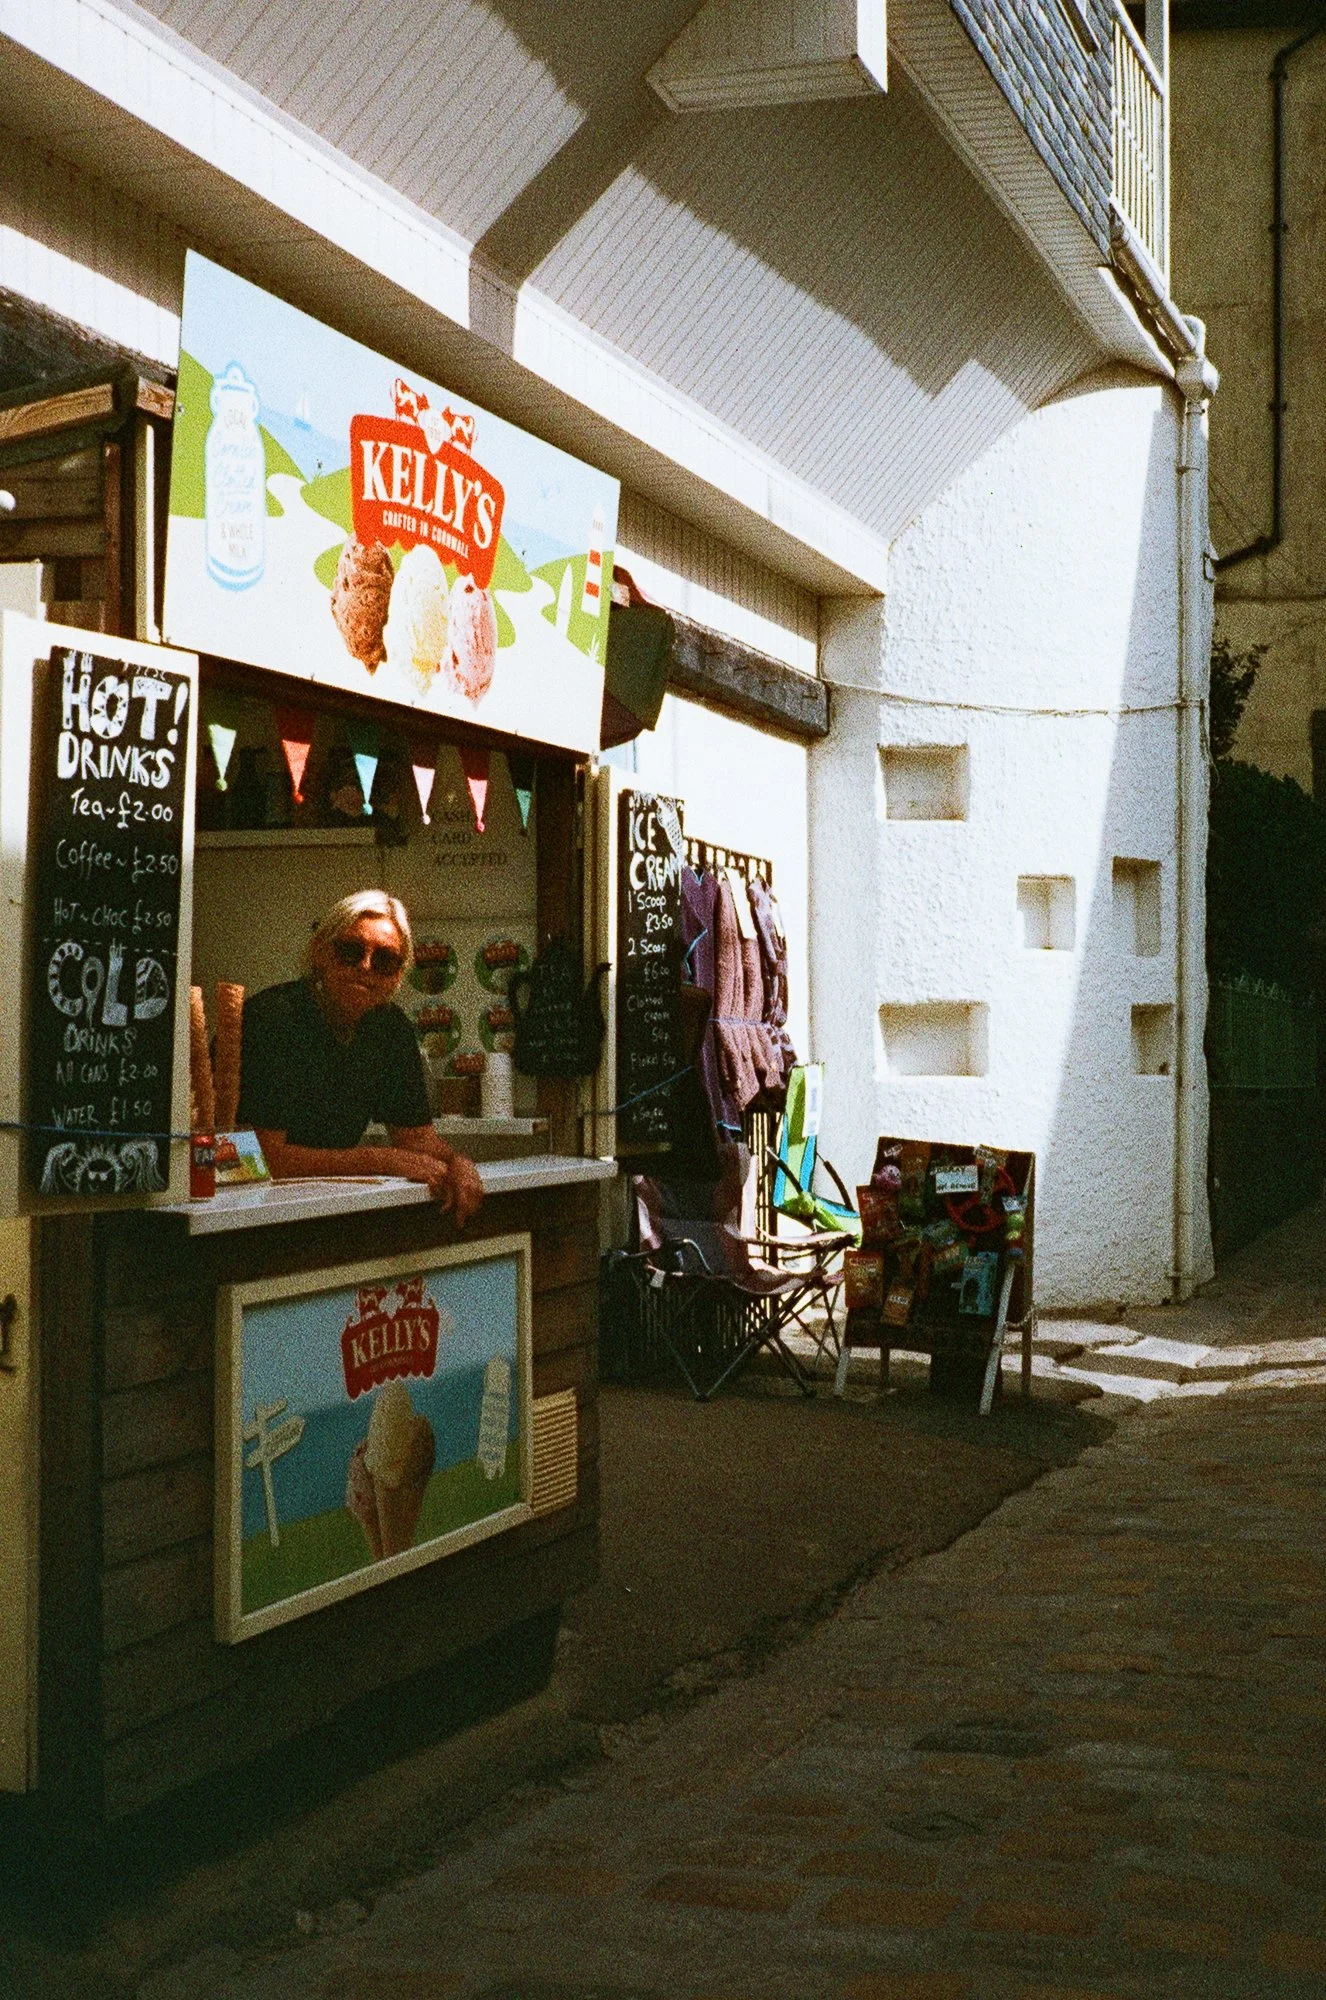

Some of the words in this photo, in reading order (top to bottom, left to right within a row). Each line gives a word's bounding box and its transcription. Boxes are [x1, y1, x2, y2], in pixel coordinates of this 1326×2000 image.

[360, 440, 496, 549] KELLY'S
[382, 509, 417, 534] CRAFTED
[420, 520, 429, 538] IN
[431, 525, 469, 560] CORNWALL
[57, 731, 175, 789] DRINKS
[71, 787, 106, 820] Tea
[629, 810, 657, 852] ICE
[56, 839, 112, 881] Coffee
[132, 845, 179, 884] £2.50
[637, 891, 667, 913] Scoop
[627, 937, 637, 956] 2
[640, 939, 668, 960] Scoop
[48, 940, 170, 1026] COLD
[51, 1104, 100, 1130] WATER
[351, 1315, 431, 1368] KELLY'S
